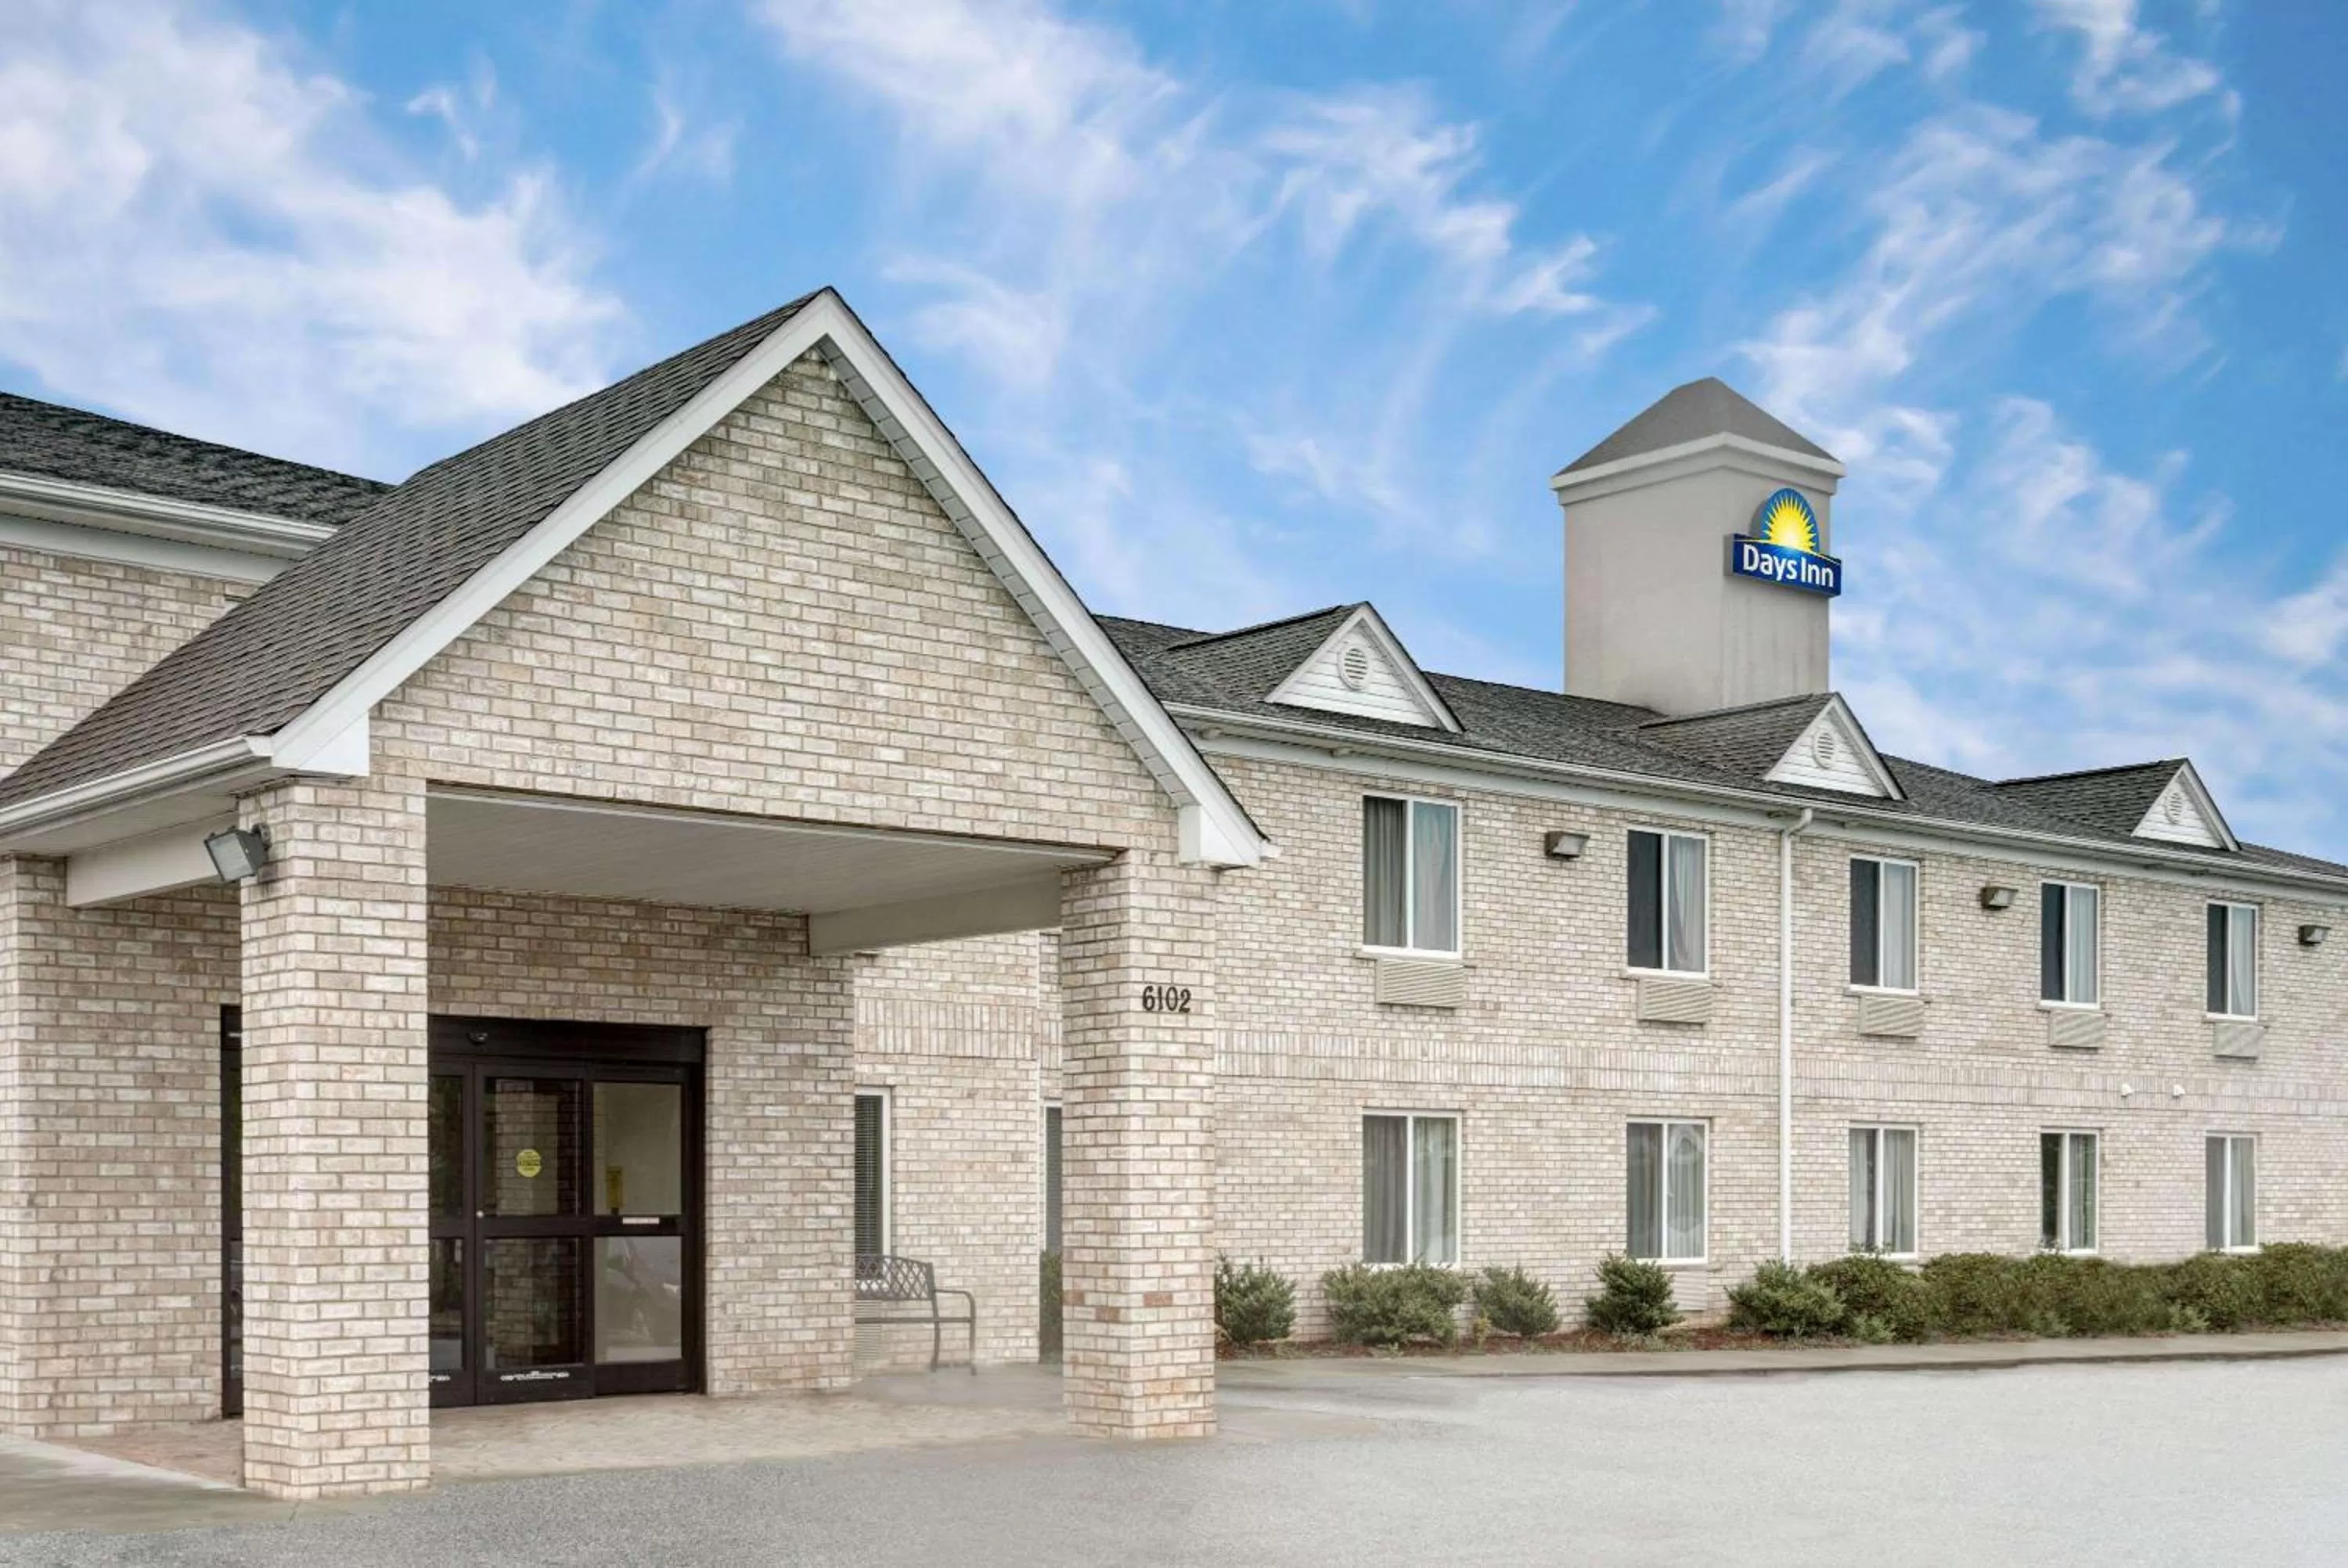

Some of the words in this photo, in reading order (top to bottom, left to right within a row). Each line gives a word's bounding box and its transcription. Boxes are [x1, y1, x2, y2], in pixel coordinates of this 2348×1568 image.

[1743, 544, 1798, 581] Days
[1801, 557, 1834, 588] Inn
[1143, 985, 1191, 1012] 6102
